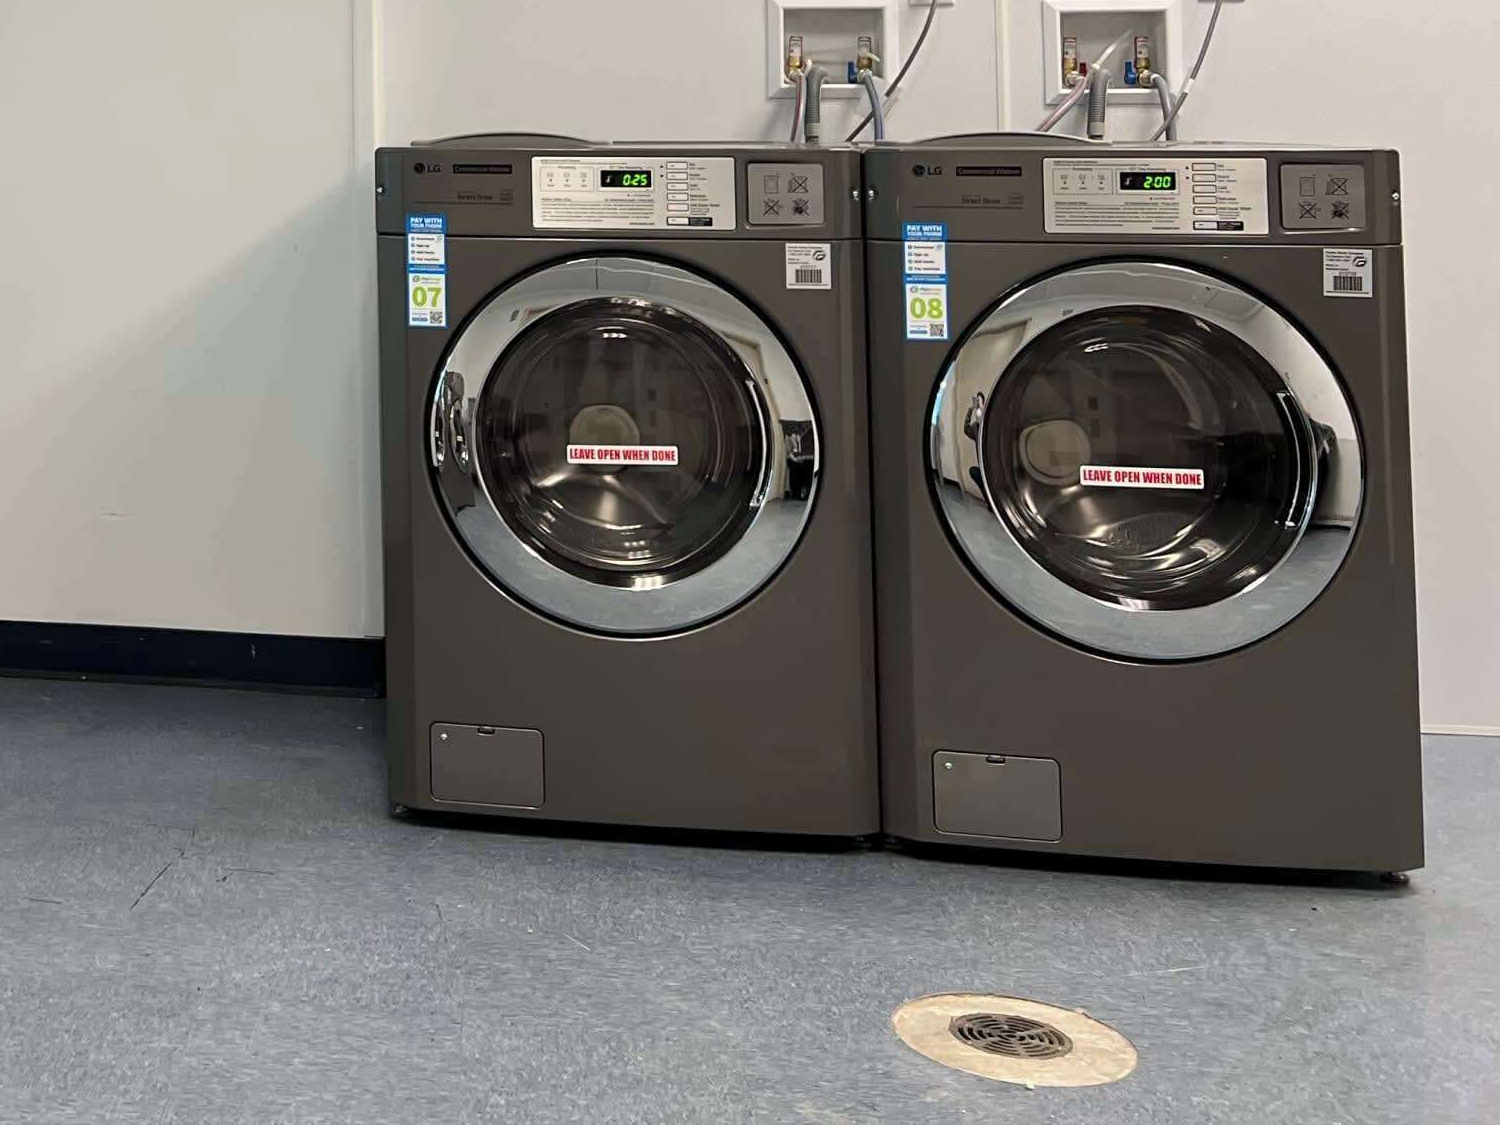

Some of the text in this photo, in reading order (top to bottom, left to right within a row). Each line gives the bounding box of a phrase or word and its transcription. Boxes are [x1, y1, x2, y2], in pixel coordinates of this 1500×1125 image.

[427, 165, 442, 173] LG
[927, 166, 942, 176] LG
[412, 286, 443, 308] 07
[909, 297, 943, 319] 08
[569, 448, 676, 462] LEAVE OPEN WHEN DONE
[1083, 469, 1201, 486] LEAVE OPEN WHEN DONE
